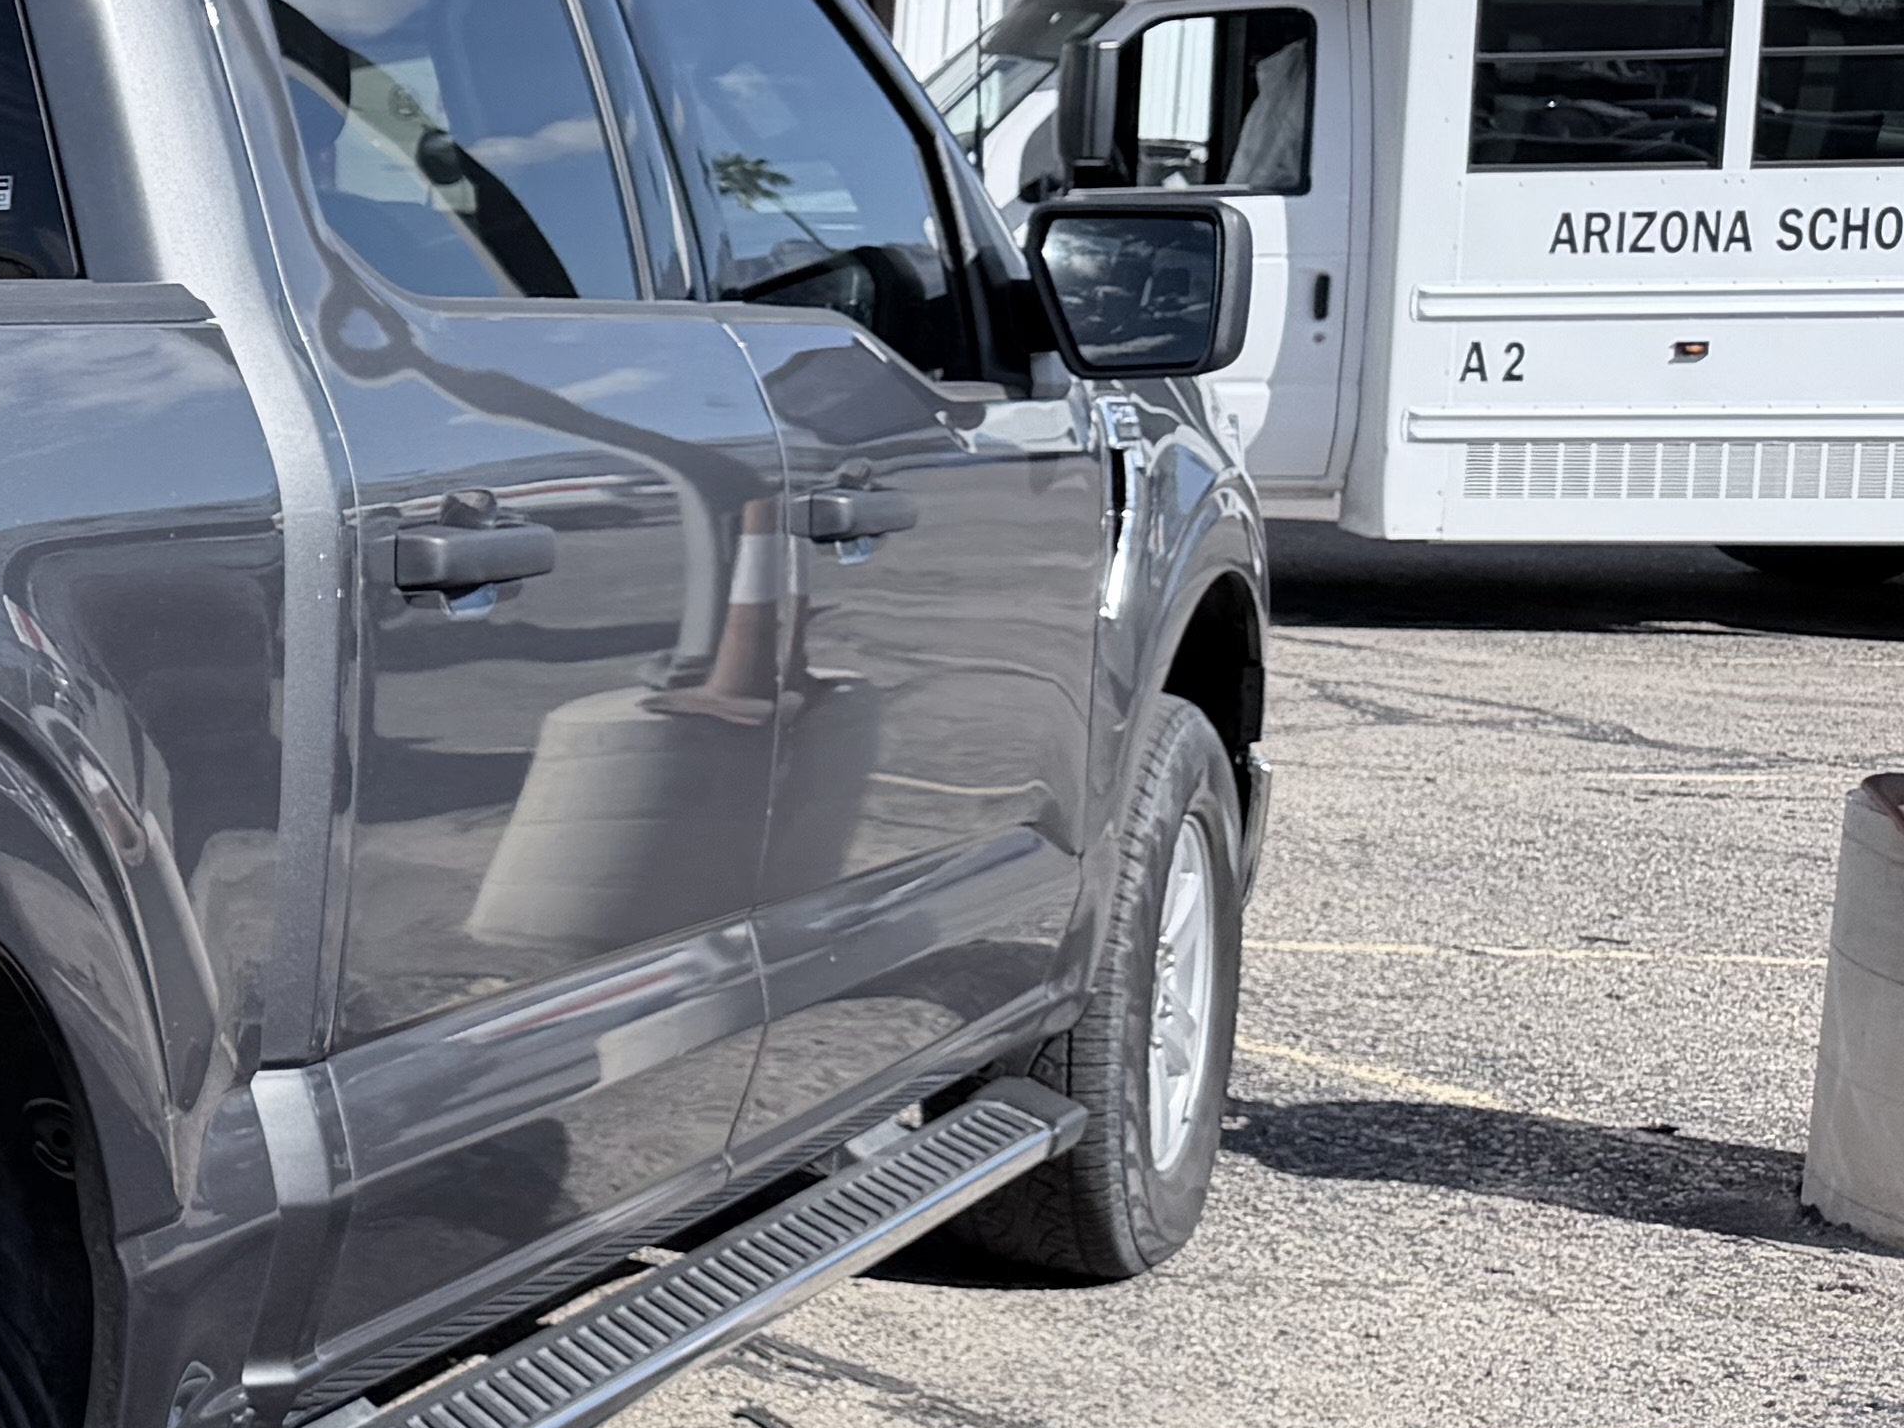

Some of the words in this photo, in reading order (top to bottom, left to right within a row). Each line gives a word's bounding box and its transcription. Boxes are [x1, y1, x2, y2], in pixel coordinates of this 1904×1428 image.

[1548, 210, 1753, 254] ARIZONA
[1776, 206, 1904, 251] SCHO
[1458, 341, 1489, 383] A
[1502, 341, 1525, 382] 2
